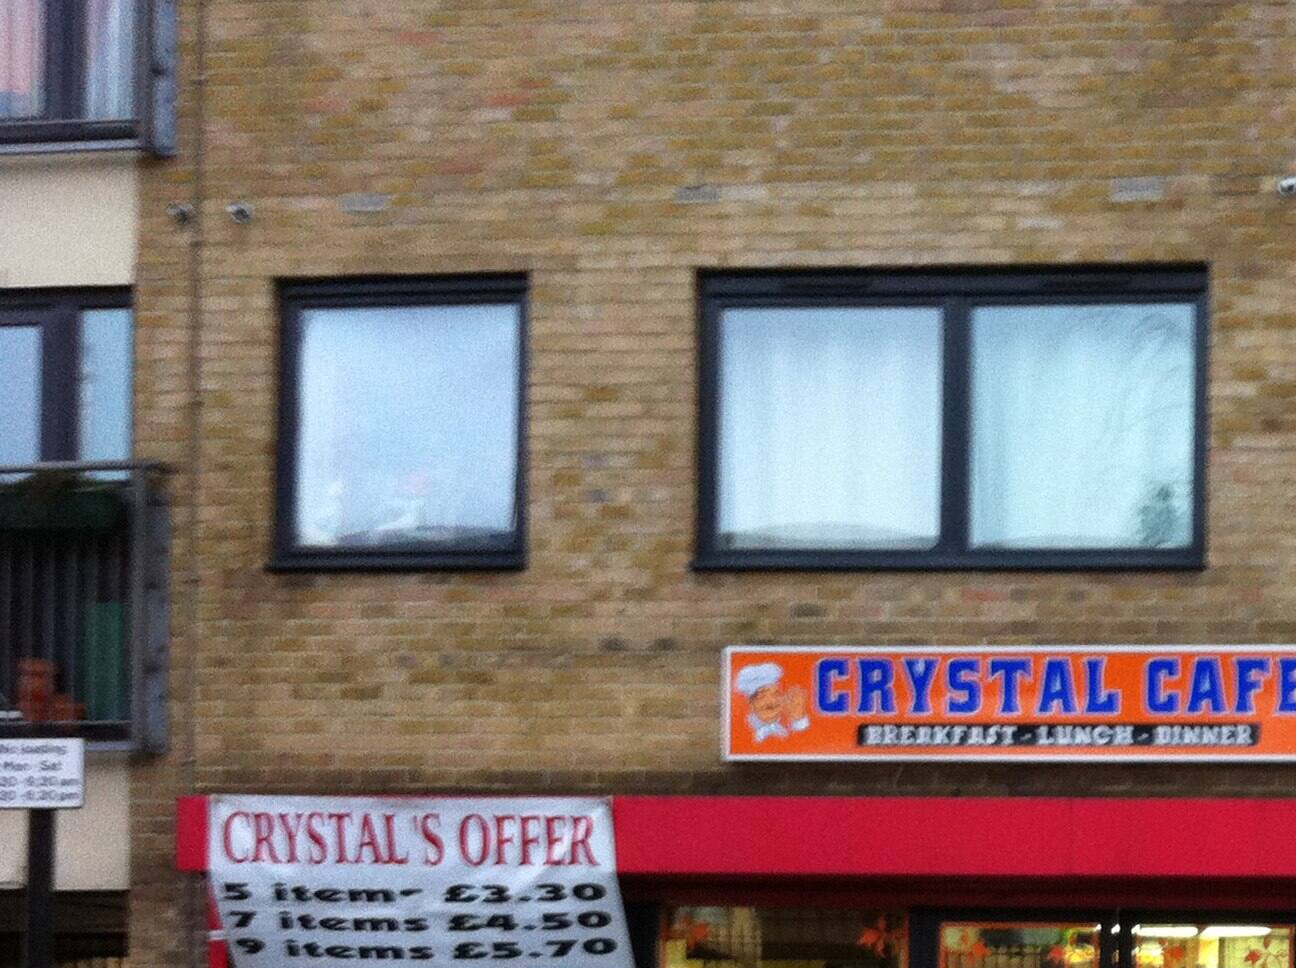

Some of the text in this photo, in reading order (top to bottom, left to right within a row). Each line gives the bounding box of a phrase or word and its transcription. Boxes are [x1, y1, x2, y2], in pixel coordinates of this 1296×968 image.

[815, 656, 1121, 716] CRYSTAL
[866, 723, 1254, 746] BREAKFAST LUNCH DINNER
[223, 811, 600, 867] CRYSTAL'S OFFER
[223, 882, 252, 902] 5
[444, 882, 608, 904] £3.30
[227, 910, 613, 933] 7 items £4.50
[236, 937, 618, 961] 9 items £5.70
